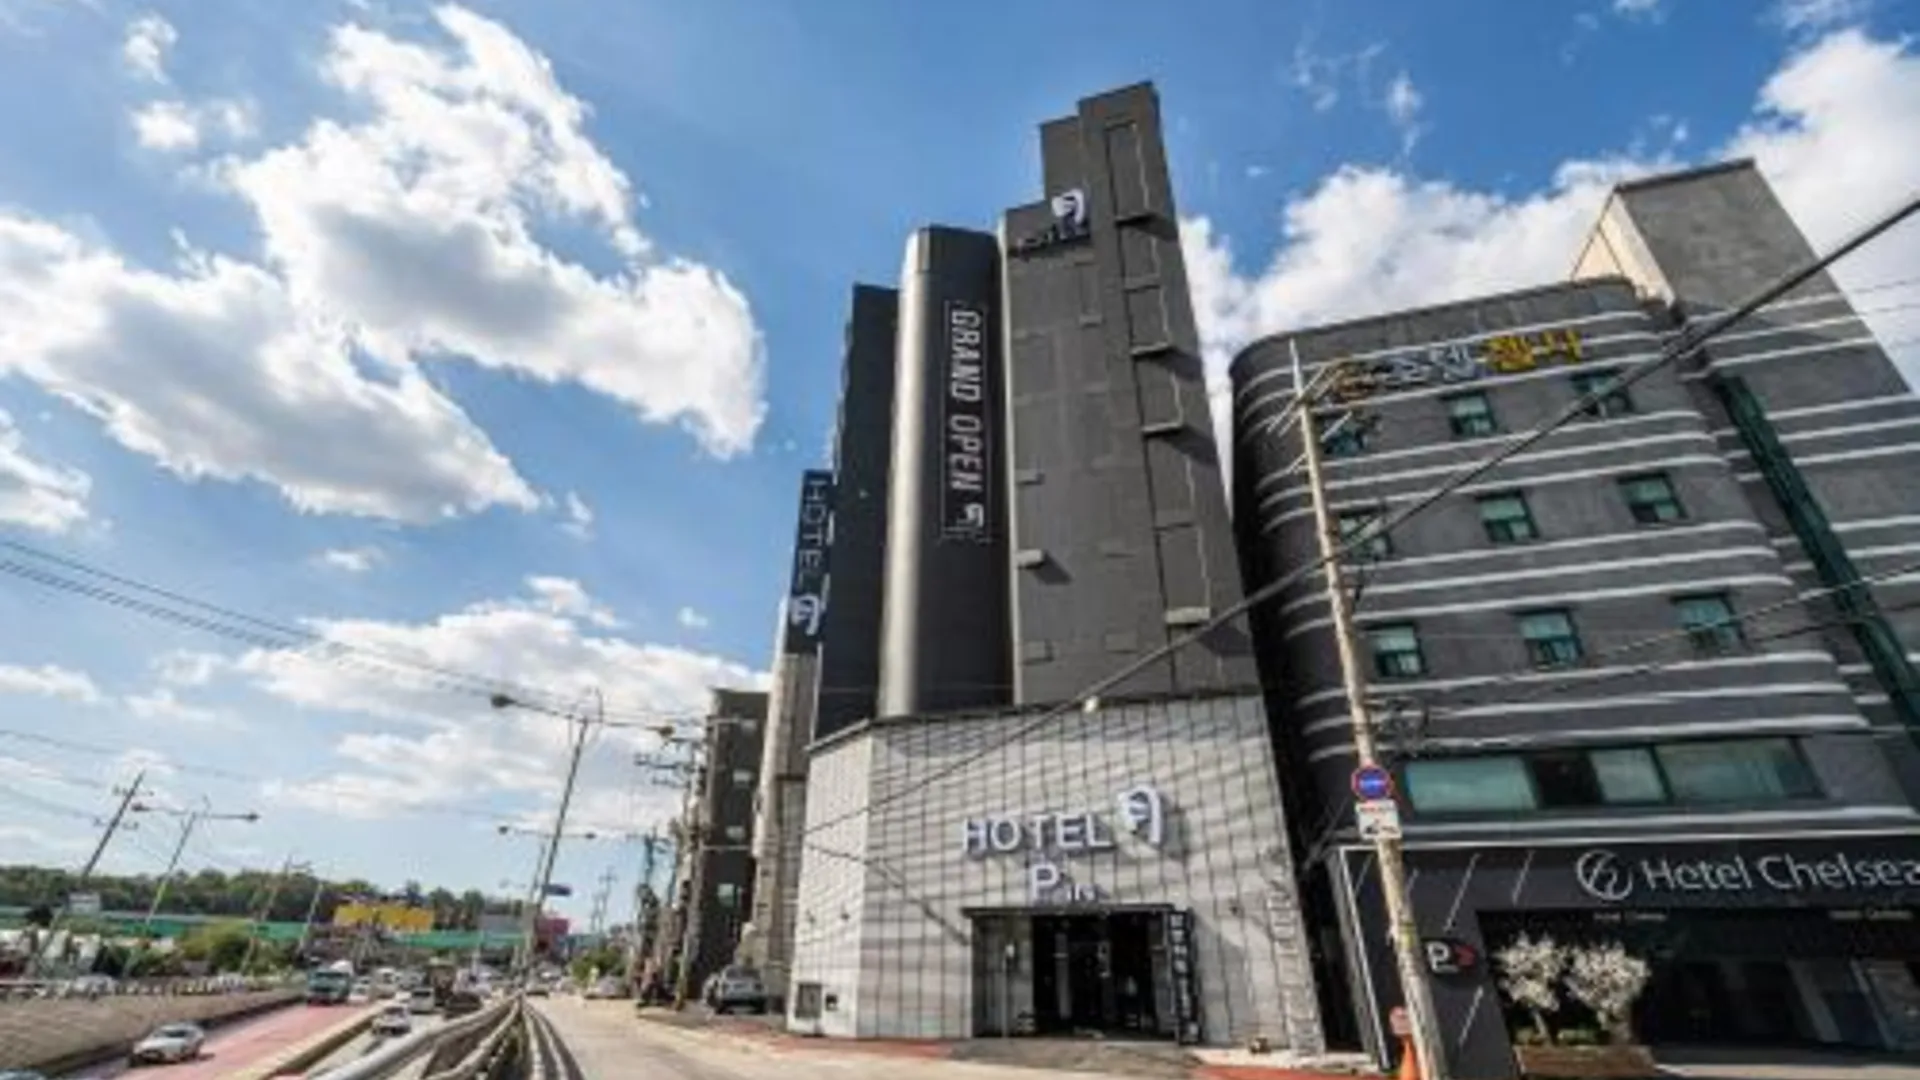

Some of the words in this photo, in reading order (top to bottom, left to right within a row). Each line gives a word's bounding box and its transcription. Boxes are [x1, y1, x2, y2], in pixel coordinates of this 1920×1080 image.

[951, 310, 982, 402] GRAND
[950, 415, 983, 491] OPEN
[963, 811, 1112, 851] HOTEL
[1640, 855, 1752, 890] Hotel
